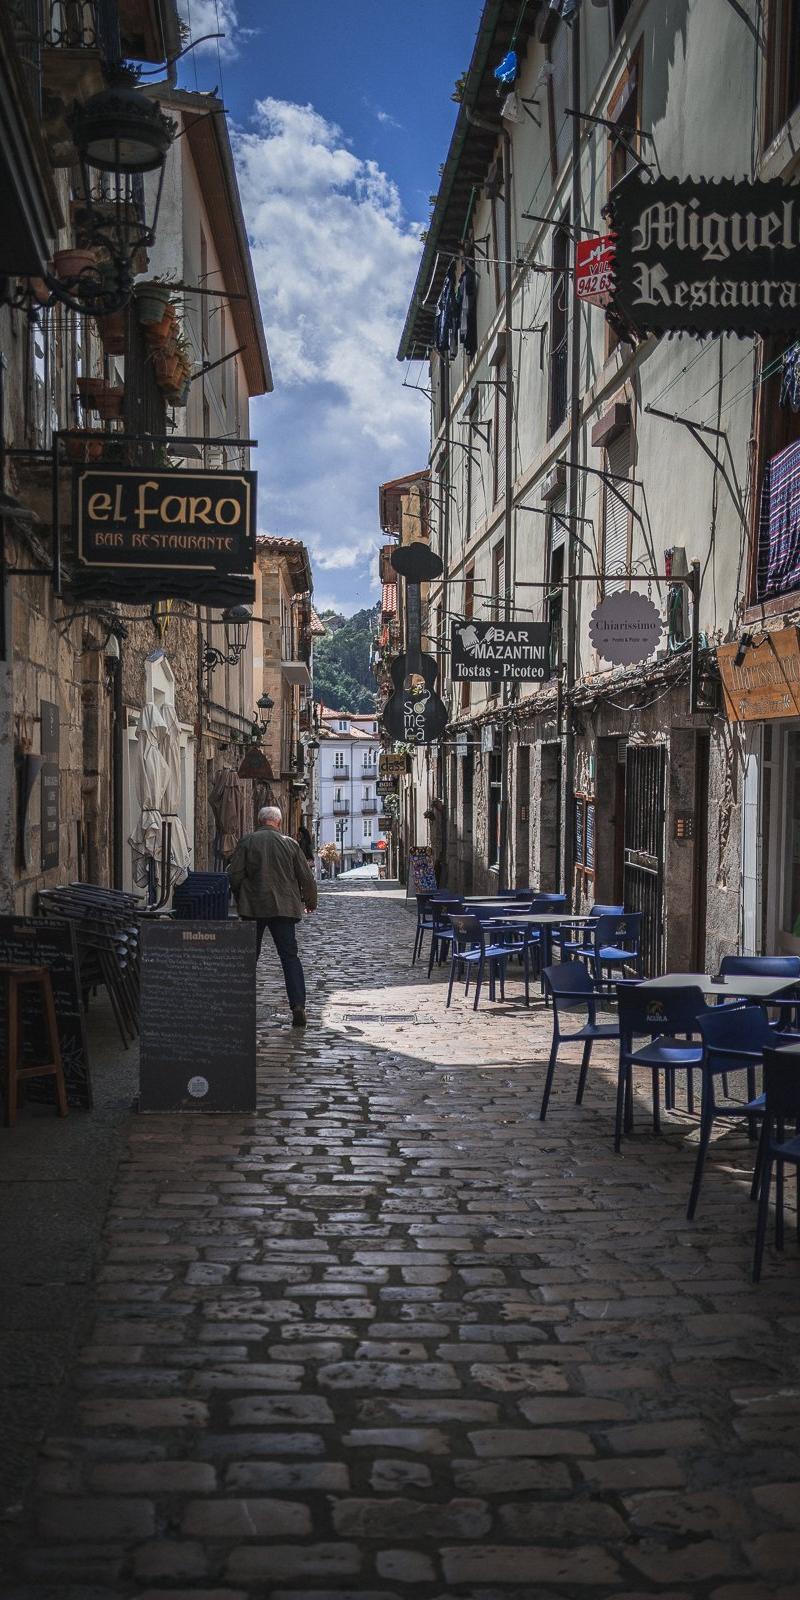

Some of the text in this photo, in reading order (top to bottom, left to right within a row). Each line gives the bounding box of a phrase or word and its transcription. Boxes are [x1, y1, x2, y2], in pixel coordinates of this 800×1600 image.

[631, 198, 800, 262] Miguel
[589, 261, 611, 275] VIL
[578, 277, 598, 294] 942
[631, 261, 800, 310] Restaura
[95, 533, 233, 550] BAR RESTAURANTE
[596, 620, 656, 631] Chiarissimo
[494, 629, 529, 642] BAR
[474, 644, 545, 659] MAZANTINI
[456, 663, 491, 677] Tostas
[503, 663, 545, 677] Picoteo
[182, 931, 216, 940] Mahou
